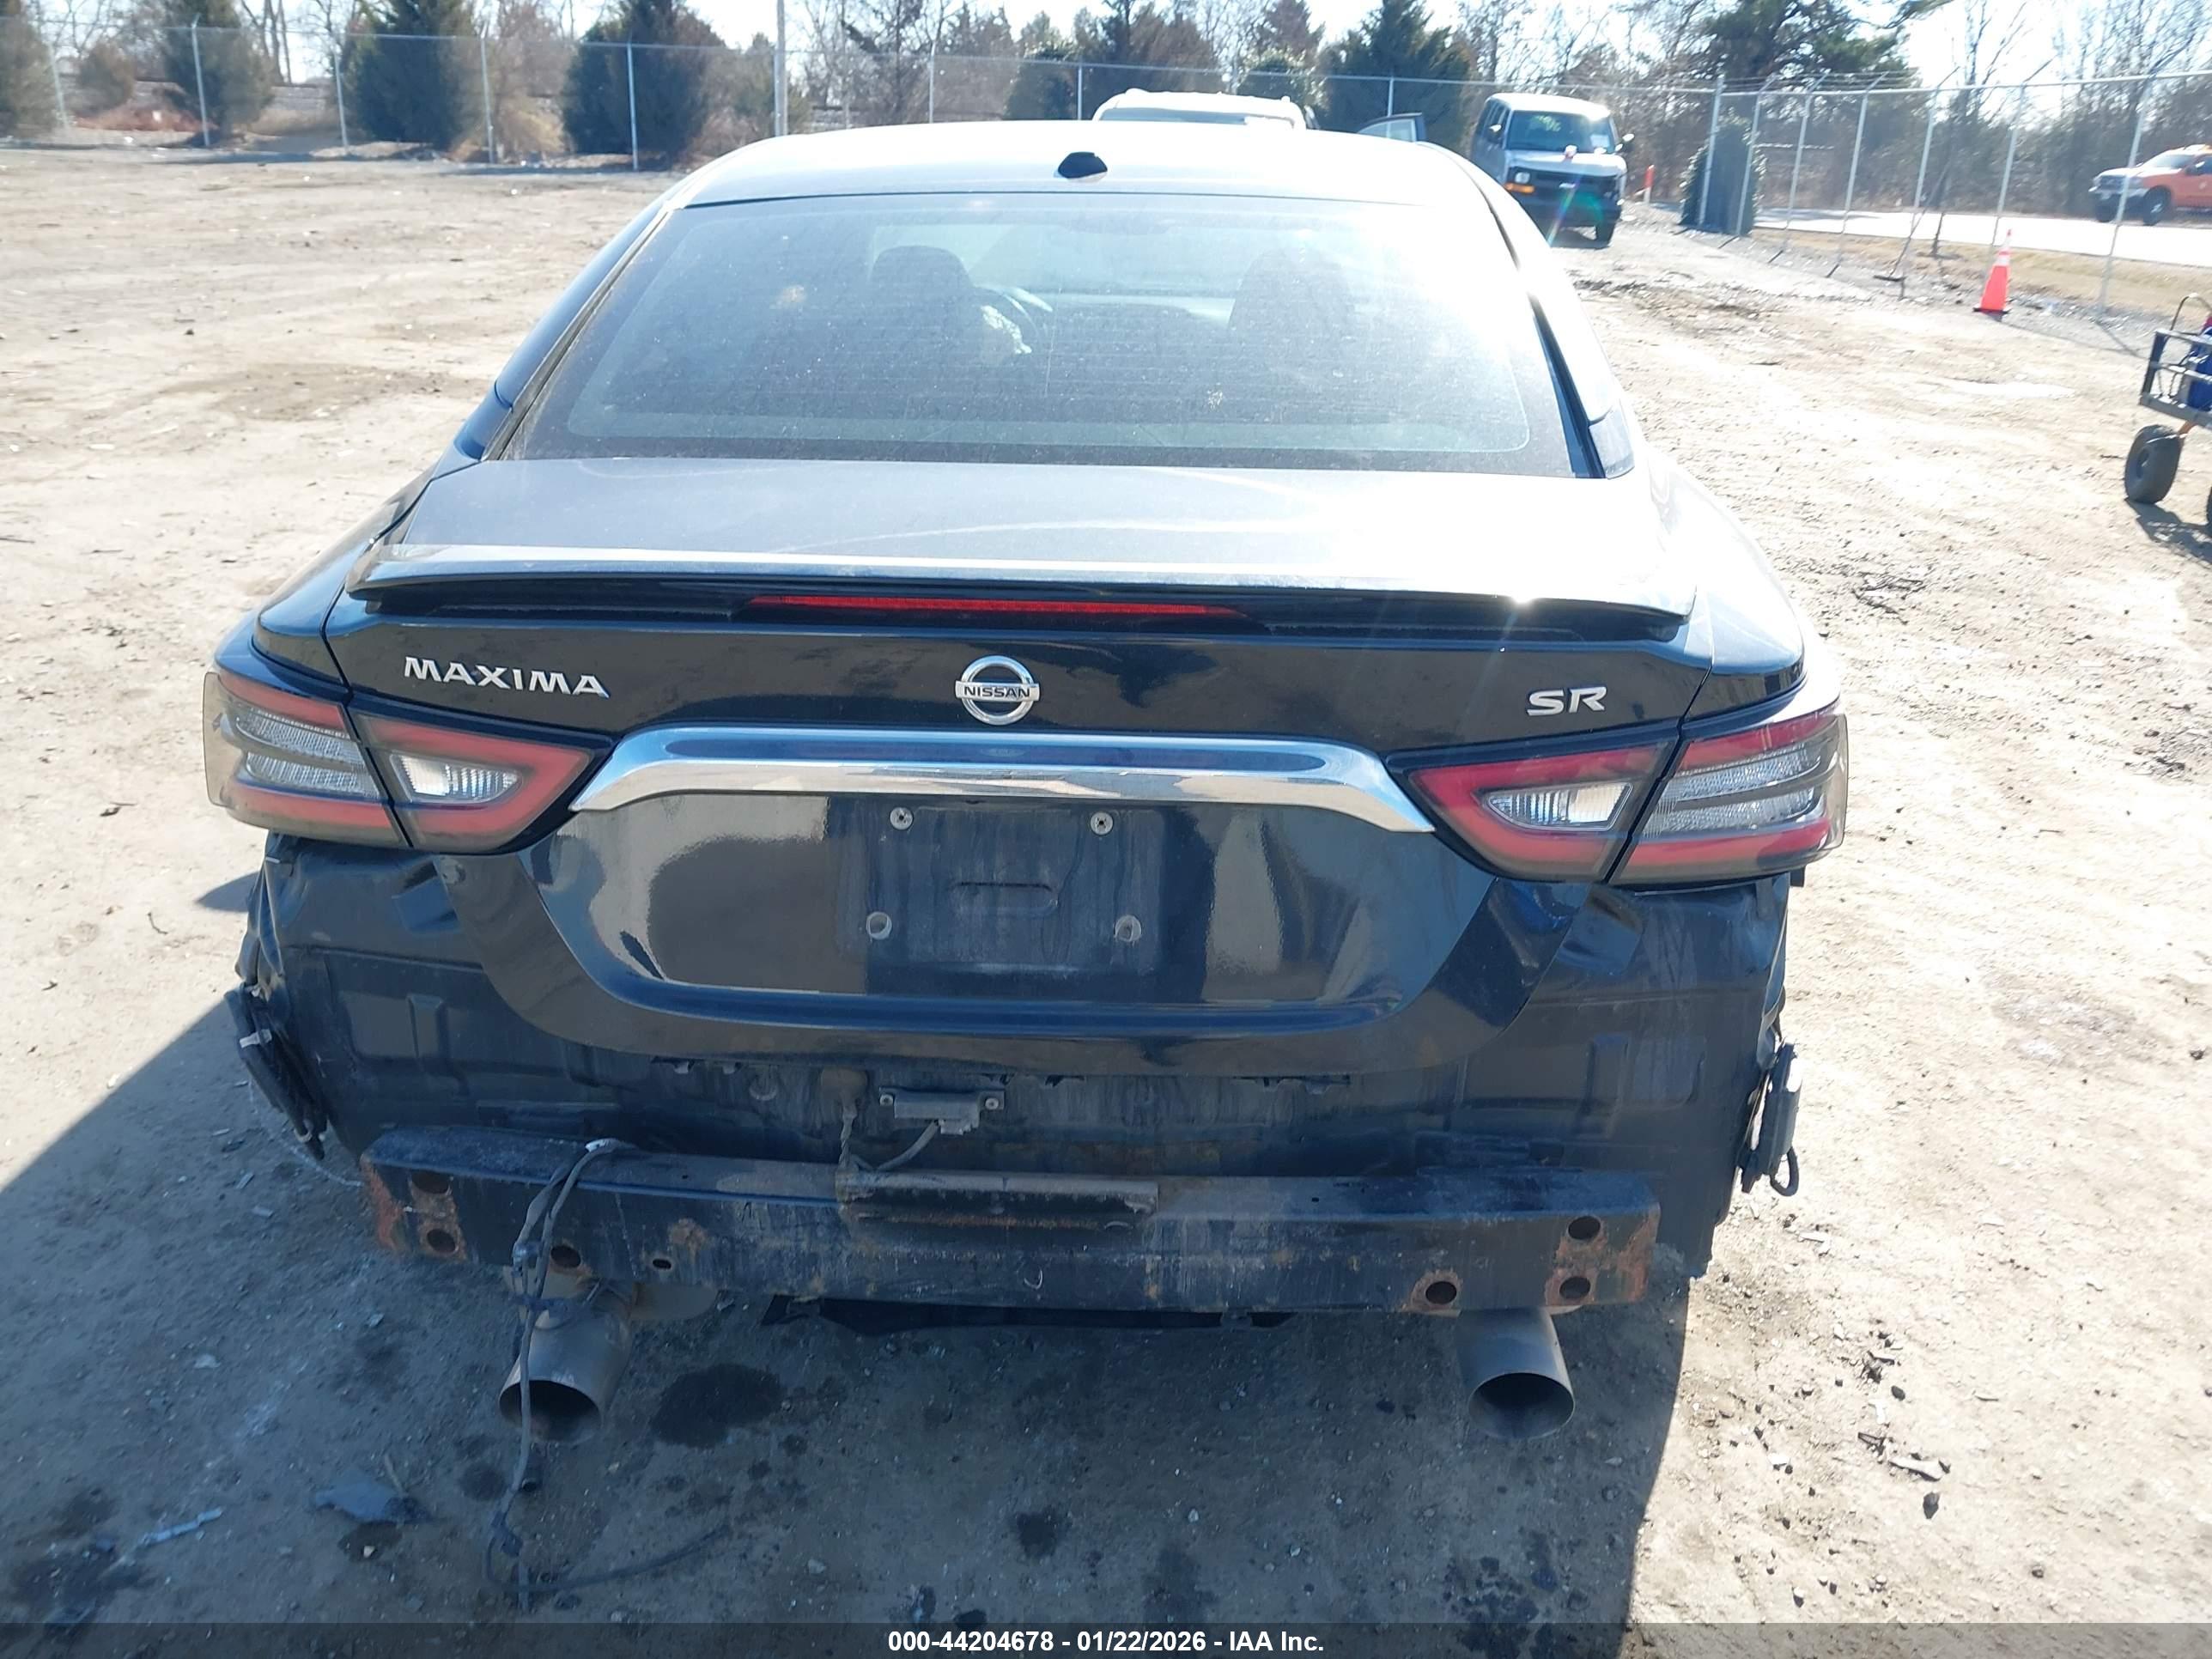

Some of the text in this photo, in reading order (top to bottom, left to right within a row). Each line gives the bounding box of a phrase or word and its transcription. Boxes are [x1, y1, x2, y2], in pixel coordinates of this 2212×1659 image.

[404, 656, 611, 699] MAXIMA
[963, 686, 1030, 698] NISSAN
[1527, 686, 1607, 716] SR
